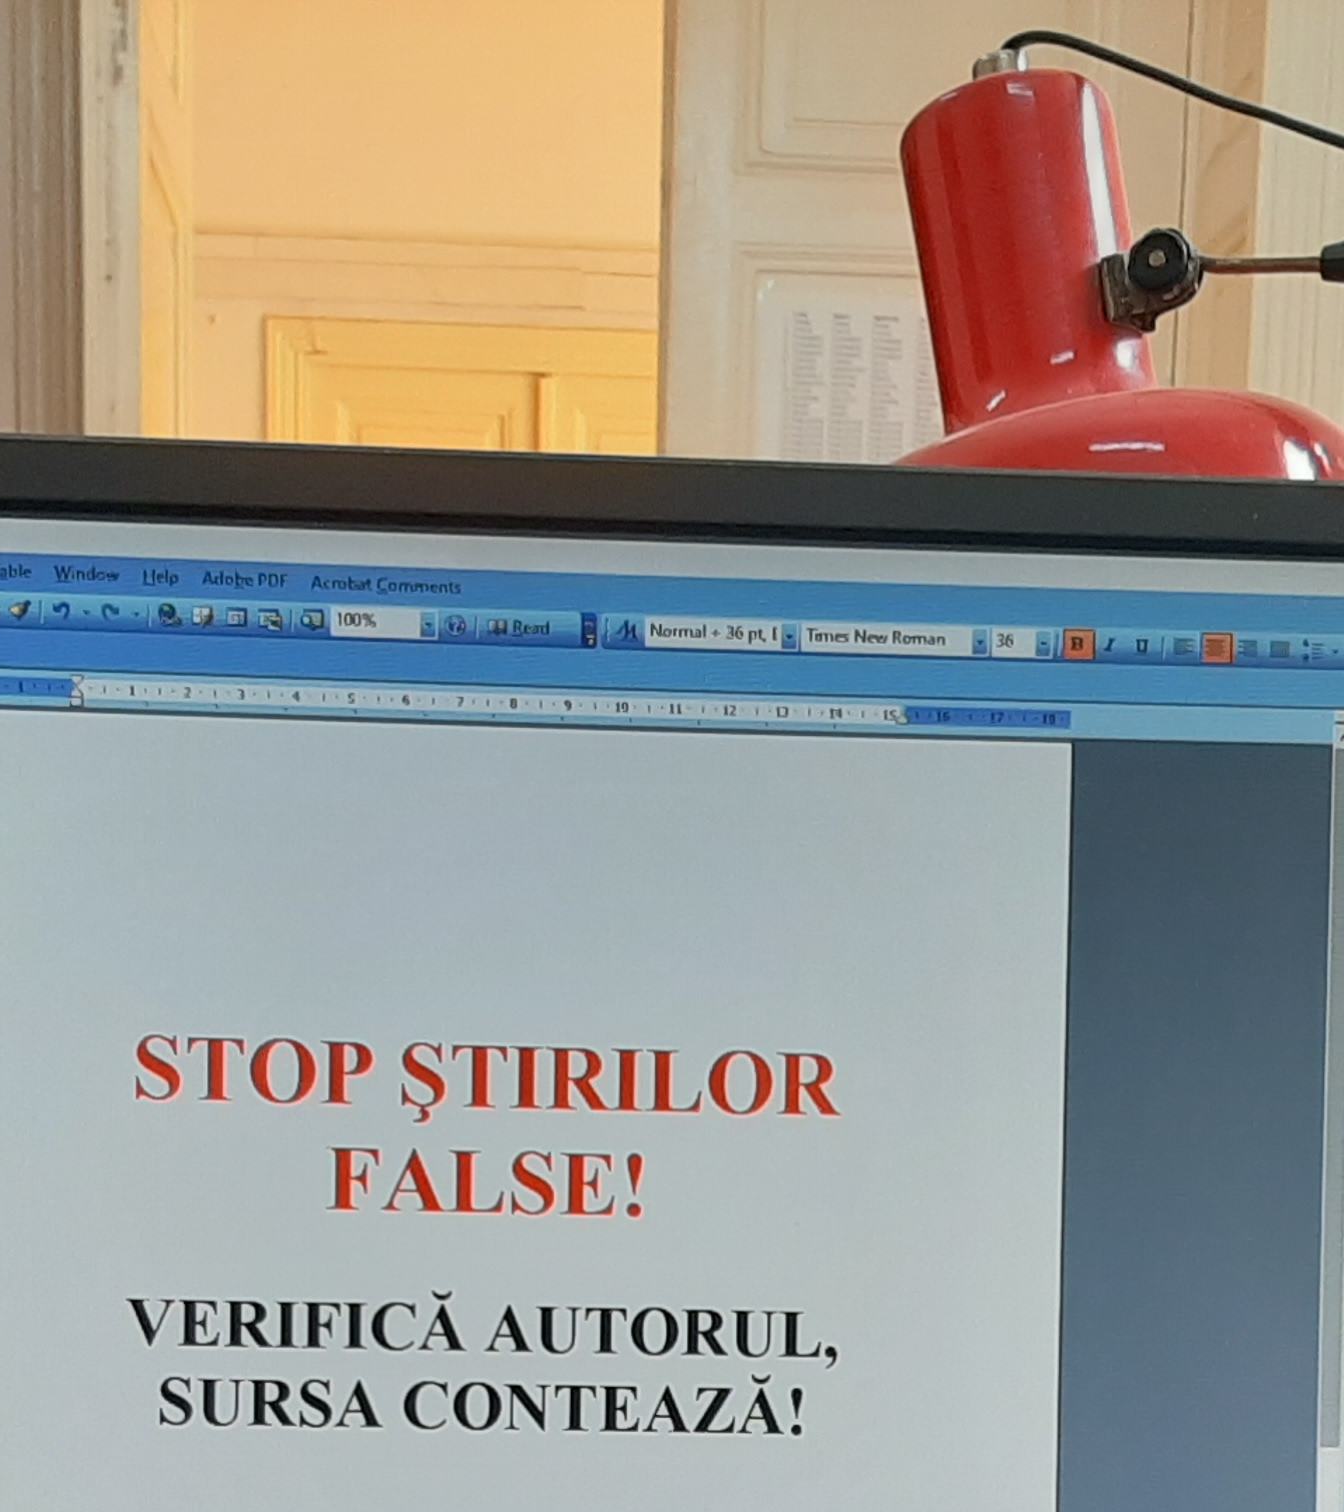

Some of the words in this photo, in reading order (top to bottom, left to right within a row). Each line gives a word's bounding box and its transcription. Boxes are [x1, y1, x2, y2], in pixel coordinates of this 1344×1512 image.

[54, 565, 120, 584] Window
[142, 569, 180, 588] Help
[203, 571, 254, 590] Adobe
[257, 573, 289, 588] PDF
[311, 575, 373, 593] Acrobat
[376, 577, 462, 597] Comments
[336, 612, 378, 629] 100%
[512, 619, 551, 638] Read
[650, 623, 707, 641] Normal
[807, 627, 850, 645] Times
[855, 629, 888, 646] New
[892, 631, 947, 648] Roman
[994, 632, 1014, 650] 36
[133, 1034, 375, 1106] STOP
[326, 1146, 644, 1218] FALSE!
[127, 1290, 467, 1352] VERIFICĂ
[485, 1305, 840, 1369] AUTORUL,
[158, 1376, 383, 1429] SURSA
[403, 1373, 805, 1437] CONTEAZĂ!
